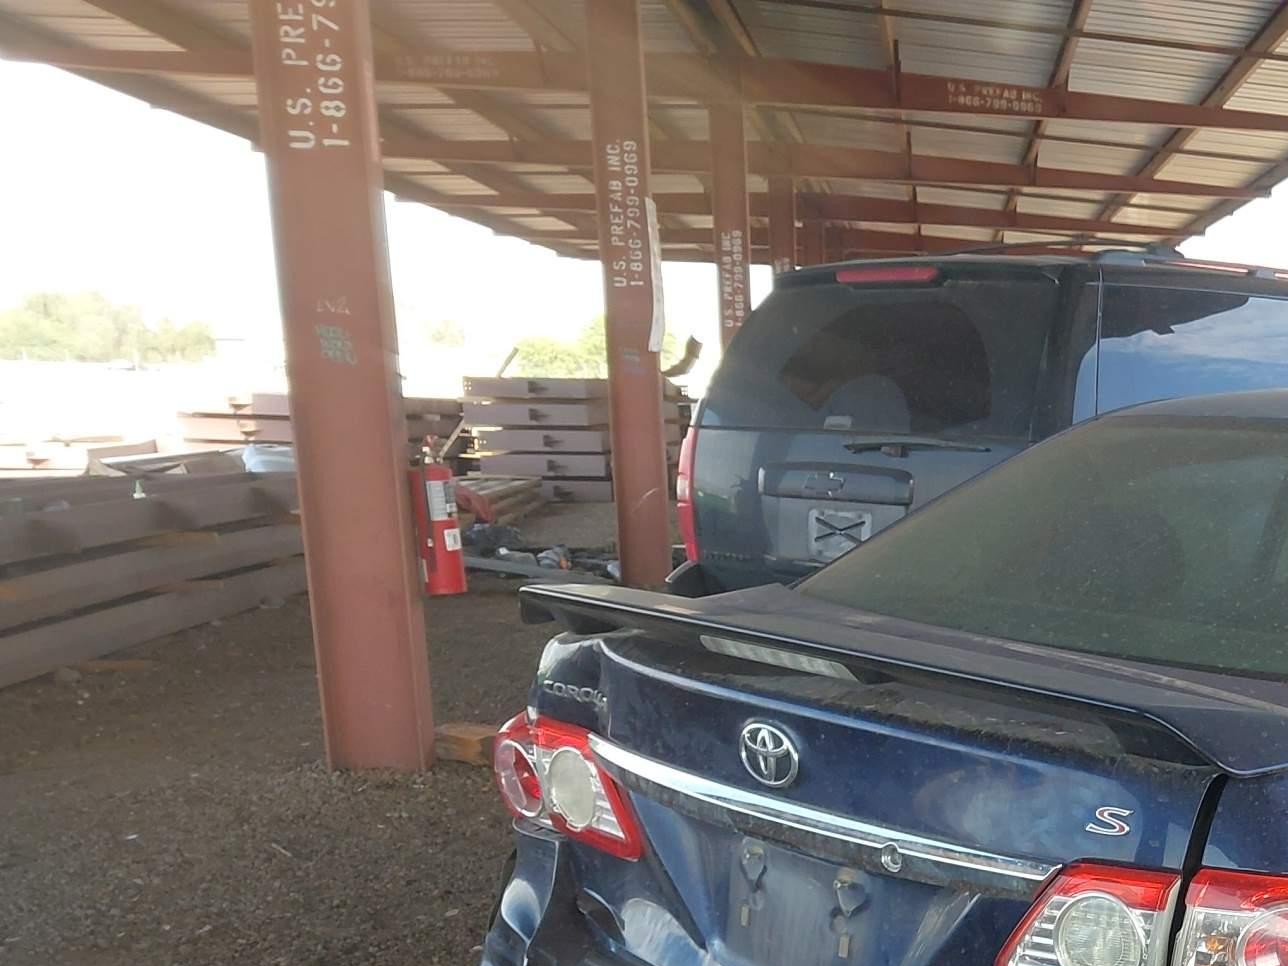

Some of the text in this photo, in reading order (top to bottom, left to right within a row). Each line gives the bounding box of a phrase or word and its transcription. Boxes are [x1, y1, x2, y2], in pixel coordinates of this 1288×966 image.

[286, 87, 316, 149] U.S.
[606, 139, 627, 288] U.S. PREFAB INC.
[623, 140, 644, 286] 1-866-799-0969
[1086, 806, 1134, 836] S
